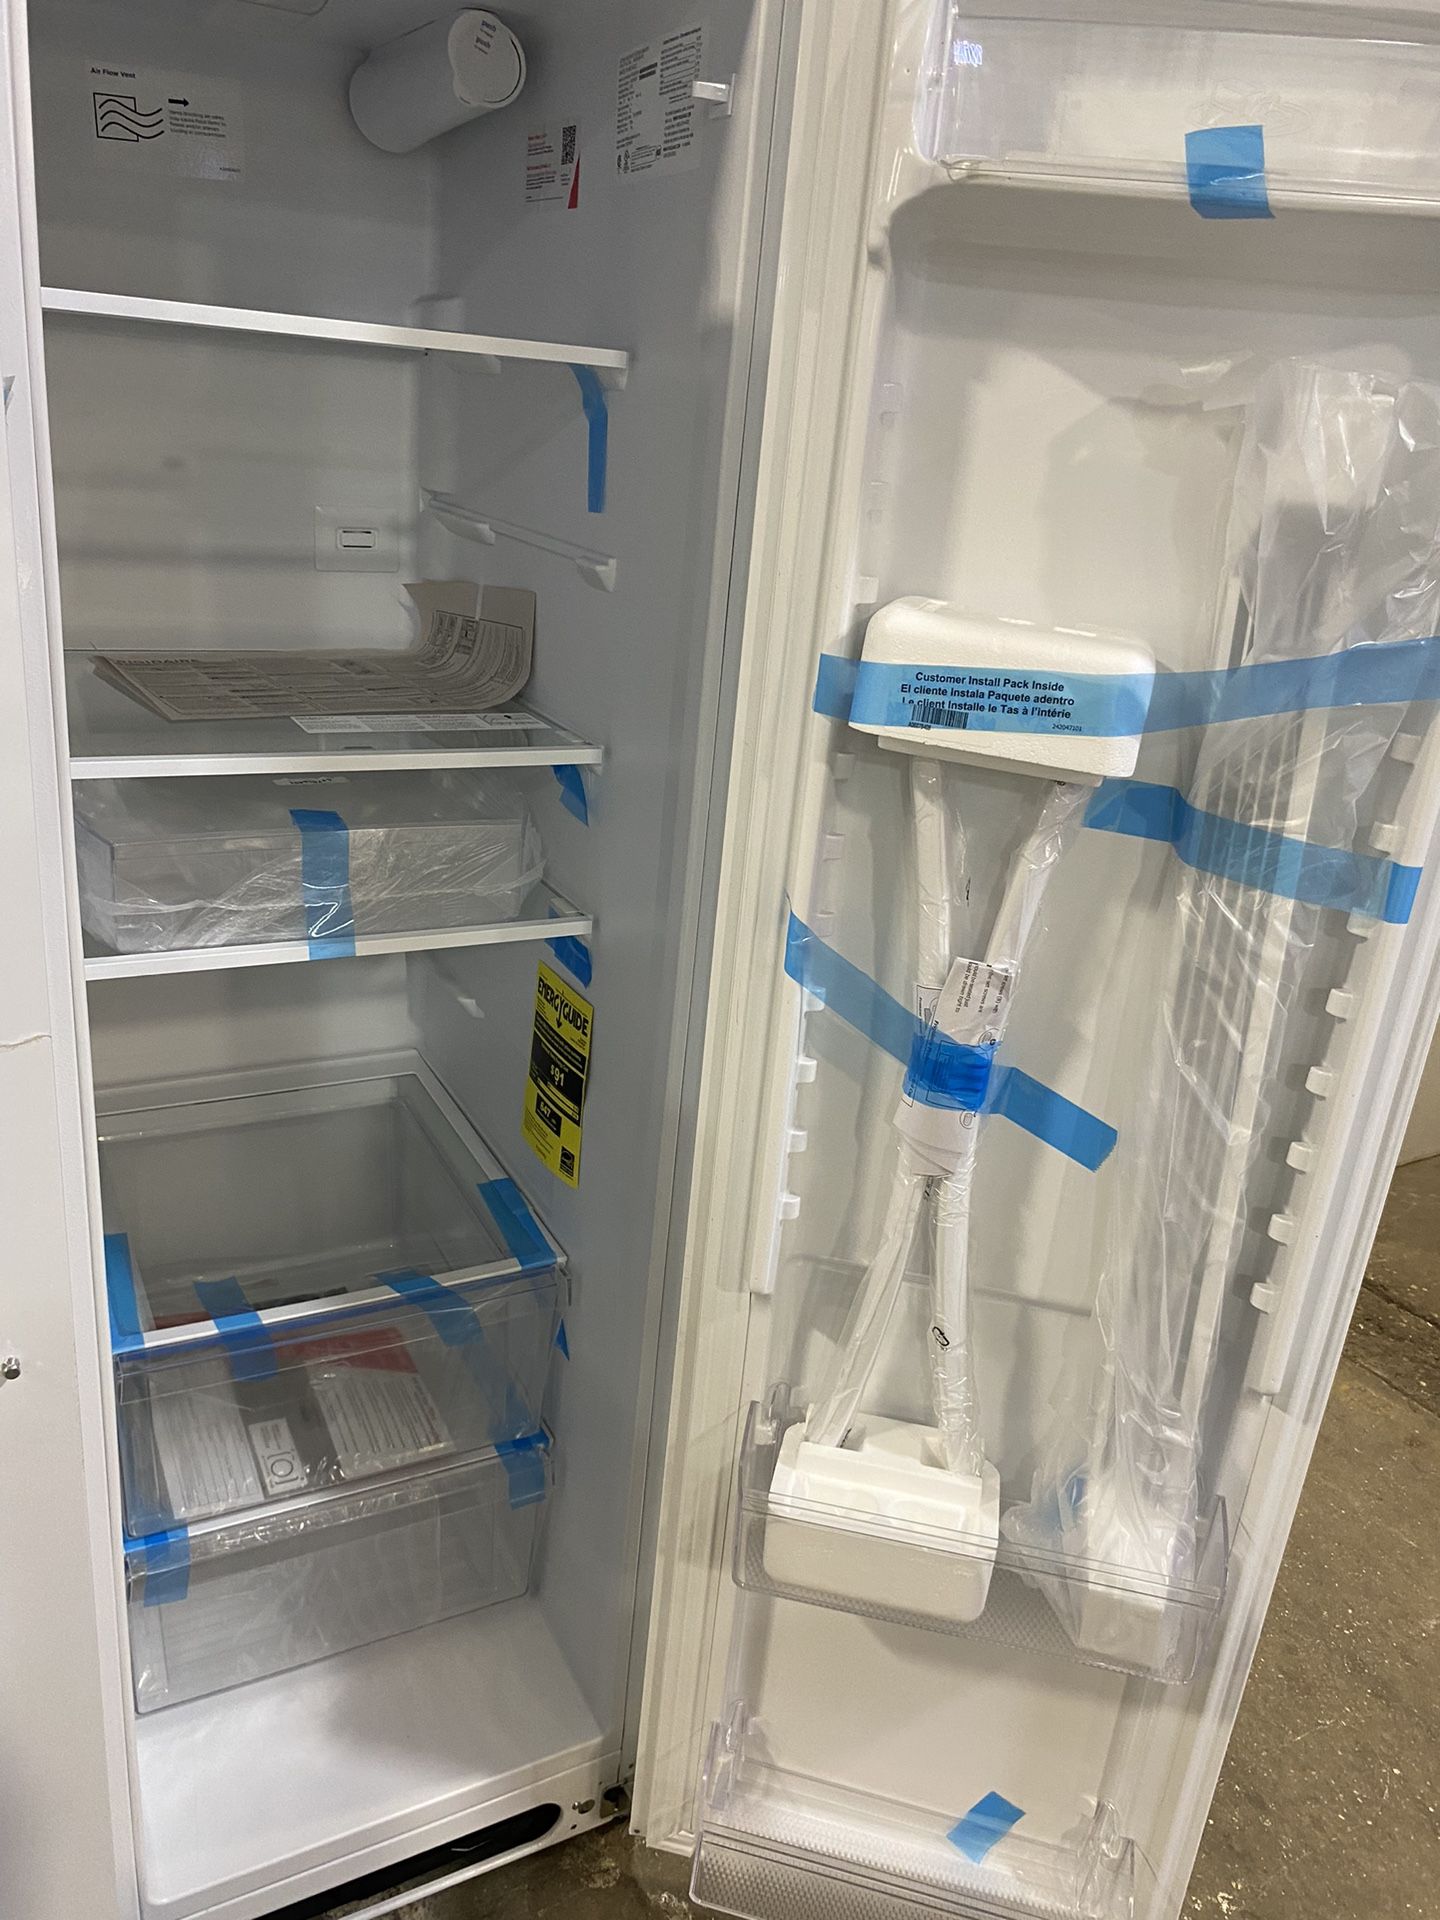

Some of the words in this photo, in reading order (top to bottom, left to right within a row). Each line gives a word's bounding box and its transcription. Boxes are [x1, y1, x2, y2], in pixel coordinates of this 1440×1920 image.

[90, 67, 101, 75] Air
[102, 68, 119, 77] Flow
[120, 71, 136, 79] Vent
[915, 671, 966, 685] Customer
[968, 675, 1001, 688] Install
[1003, 678, 1029, 690] Pack
[1032, 681, 1065, 692] Inside
[900, 684, 912, 694] El
[913, 685, 948, 697] cliente
[950, 688, 985, 700] Instala
[987, 690, 1031, 704] Paquete
[1033, 694, 1075, 706] adentro
[917, 698, 945, 710] client
[948, 700, 986, 714] Installe
[988, 703, 998, 714] le
[1000, 705, 1019, 716] Tas
[1021, 705, 1029, 716] à
